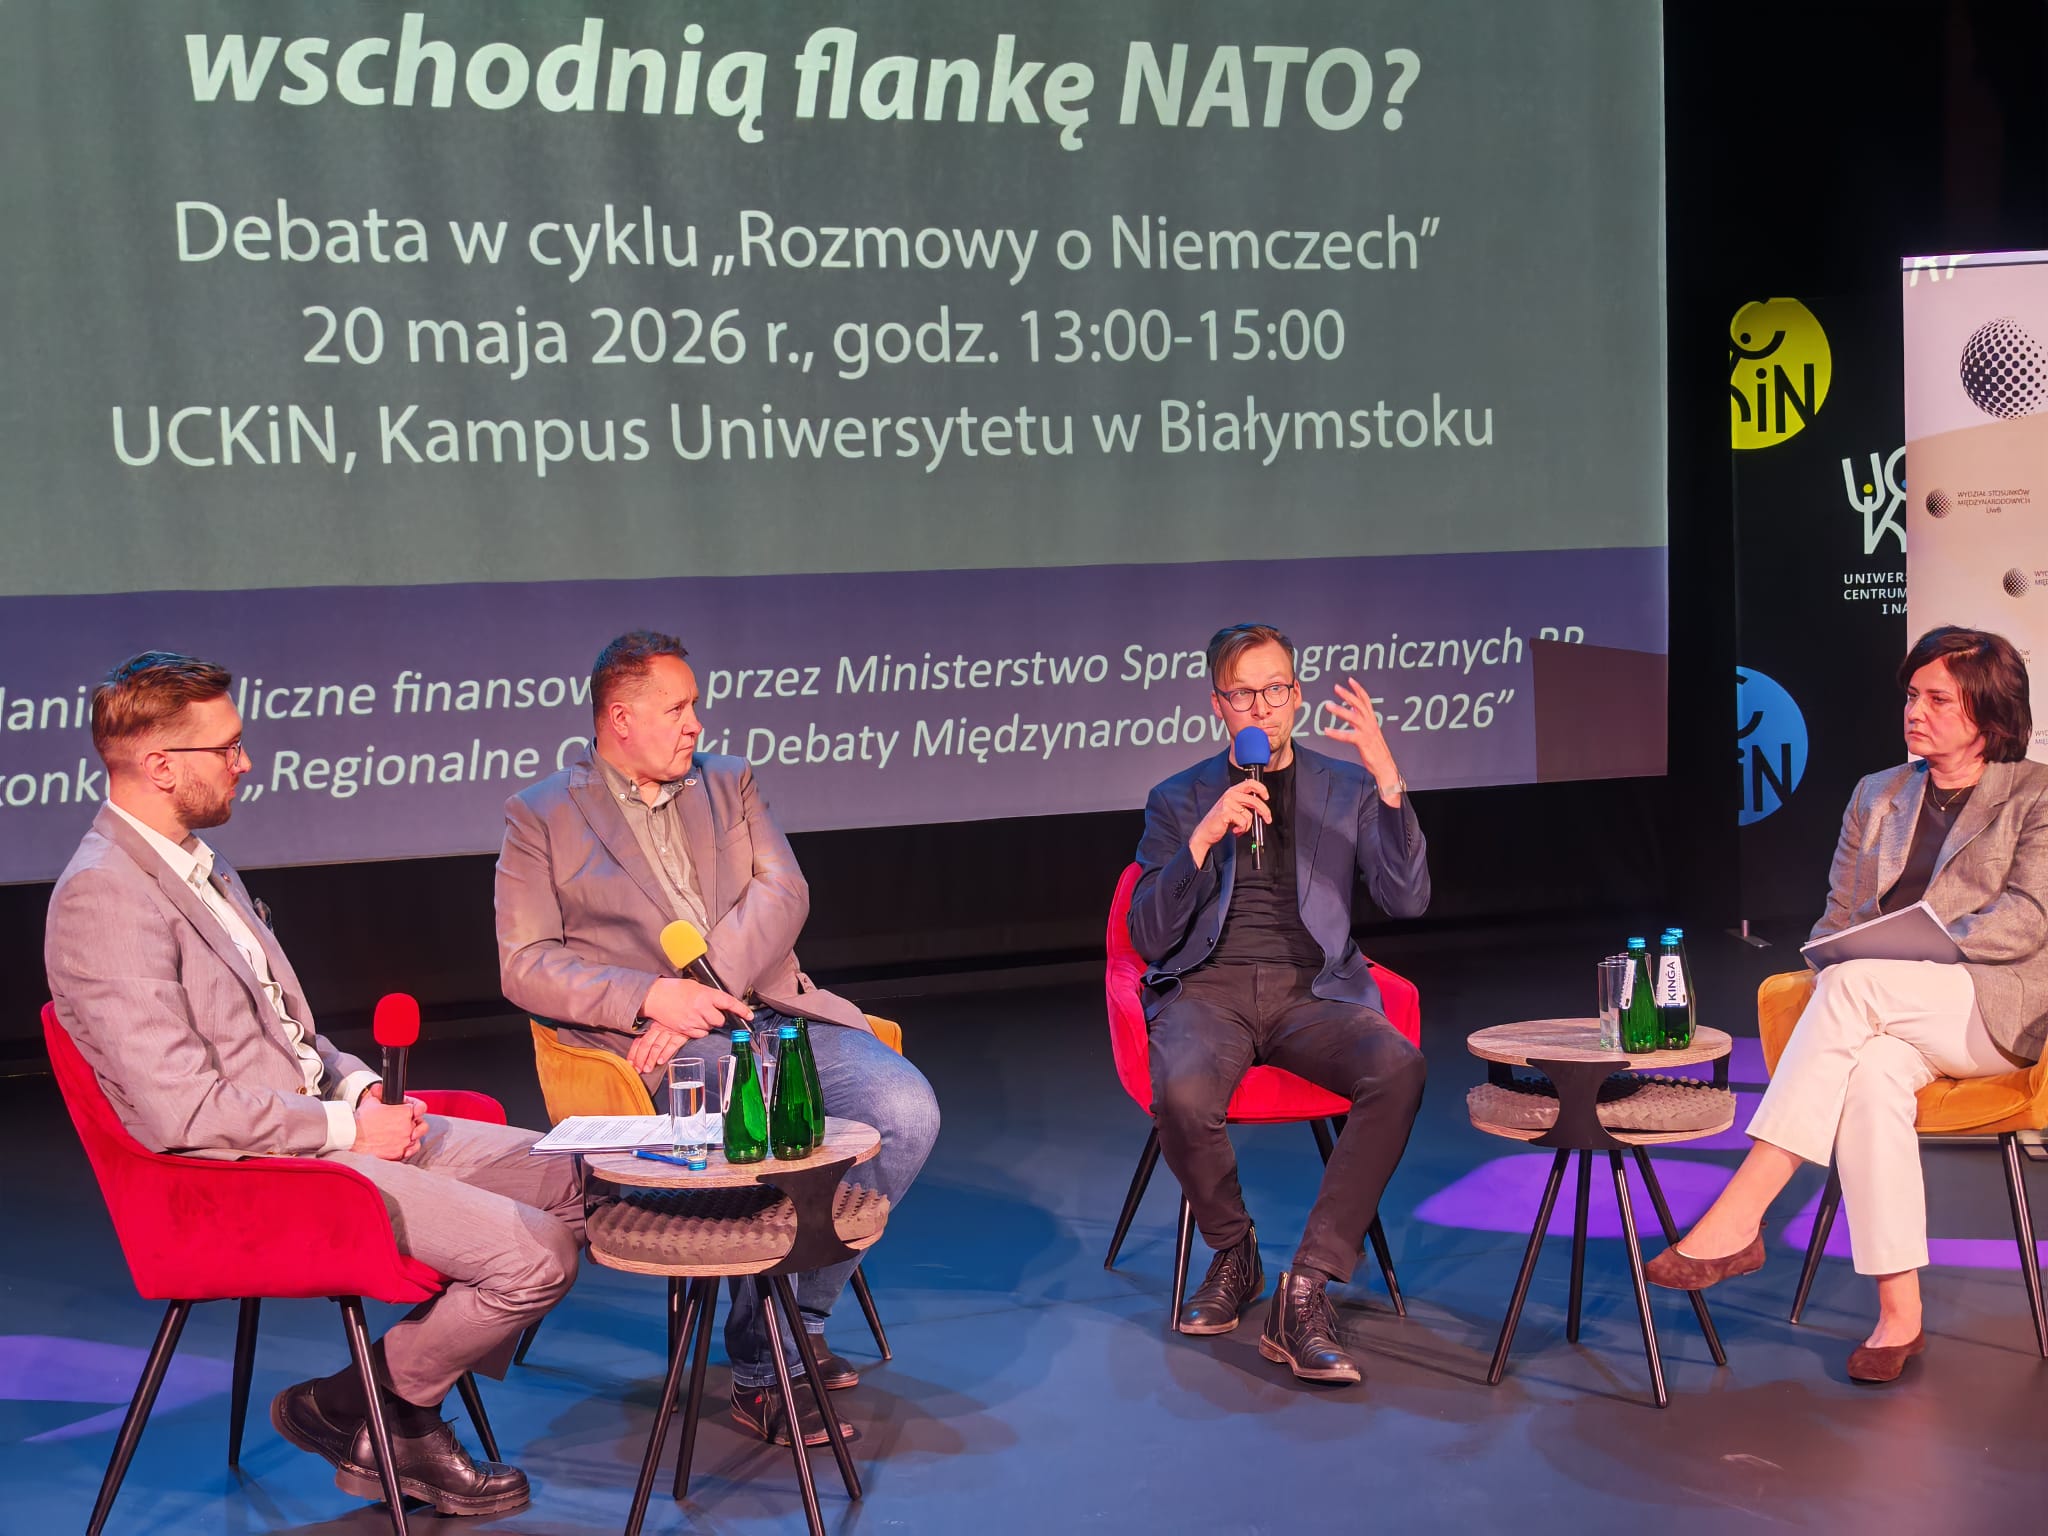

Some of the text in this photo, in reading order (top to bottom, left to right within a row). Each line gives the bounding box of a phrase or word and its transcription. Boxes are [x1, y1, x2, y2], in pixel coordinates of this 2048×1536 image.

[186, 13, 1420, 150] wschodnią flankę NATO?
[176, 198, 1440, 285] Debata w cyklu „Rozmowy o Niemczech”
[303, 306, 1344, 380] 20 maja 2026 r., godz. 13:00-15:00
[113, 393, 1492, 477] UCKiN, Kampus Uniwersytetu w Białymstoku
[1844, 572, 1906, 584] UNIWER
[1891, 603, 1907, 614] NA
[238, 678, 375, 720] liczne
[394, 671, 591, 713] finansow
[706, 667, 820, 709] przez
[837, 652, 1108, 693] Ministerstwo
[1121, 645, 1206, 689] Spra
[1294, 627, 1522, 682] granicznych
[241, 739, 539, 801] „Regionalne
[746, 723, 899, 768] Debaty
[913, 706, 1224, 763] Międzynarodow
[1667, 961, 1677, 1001] KINGA
